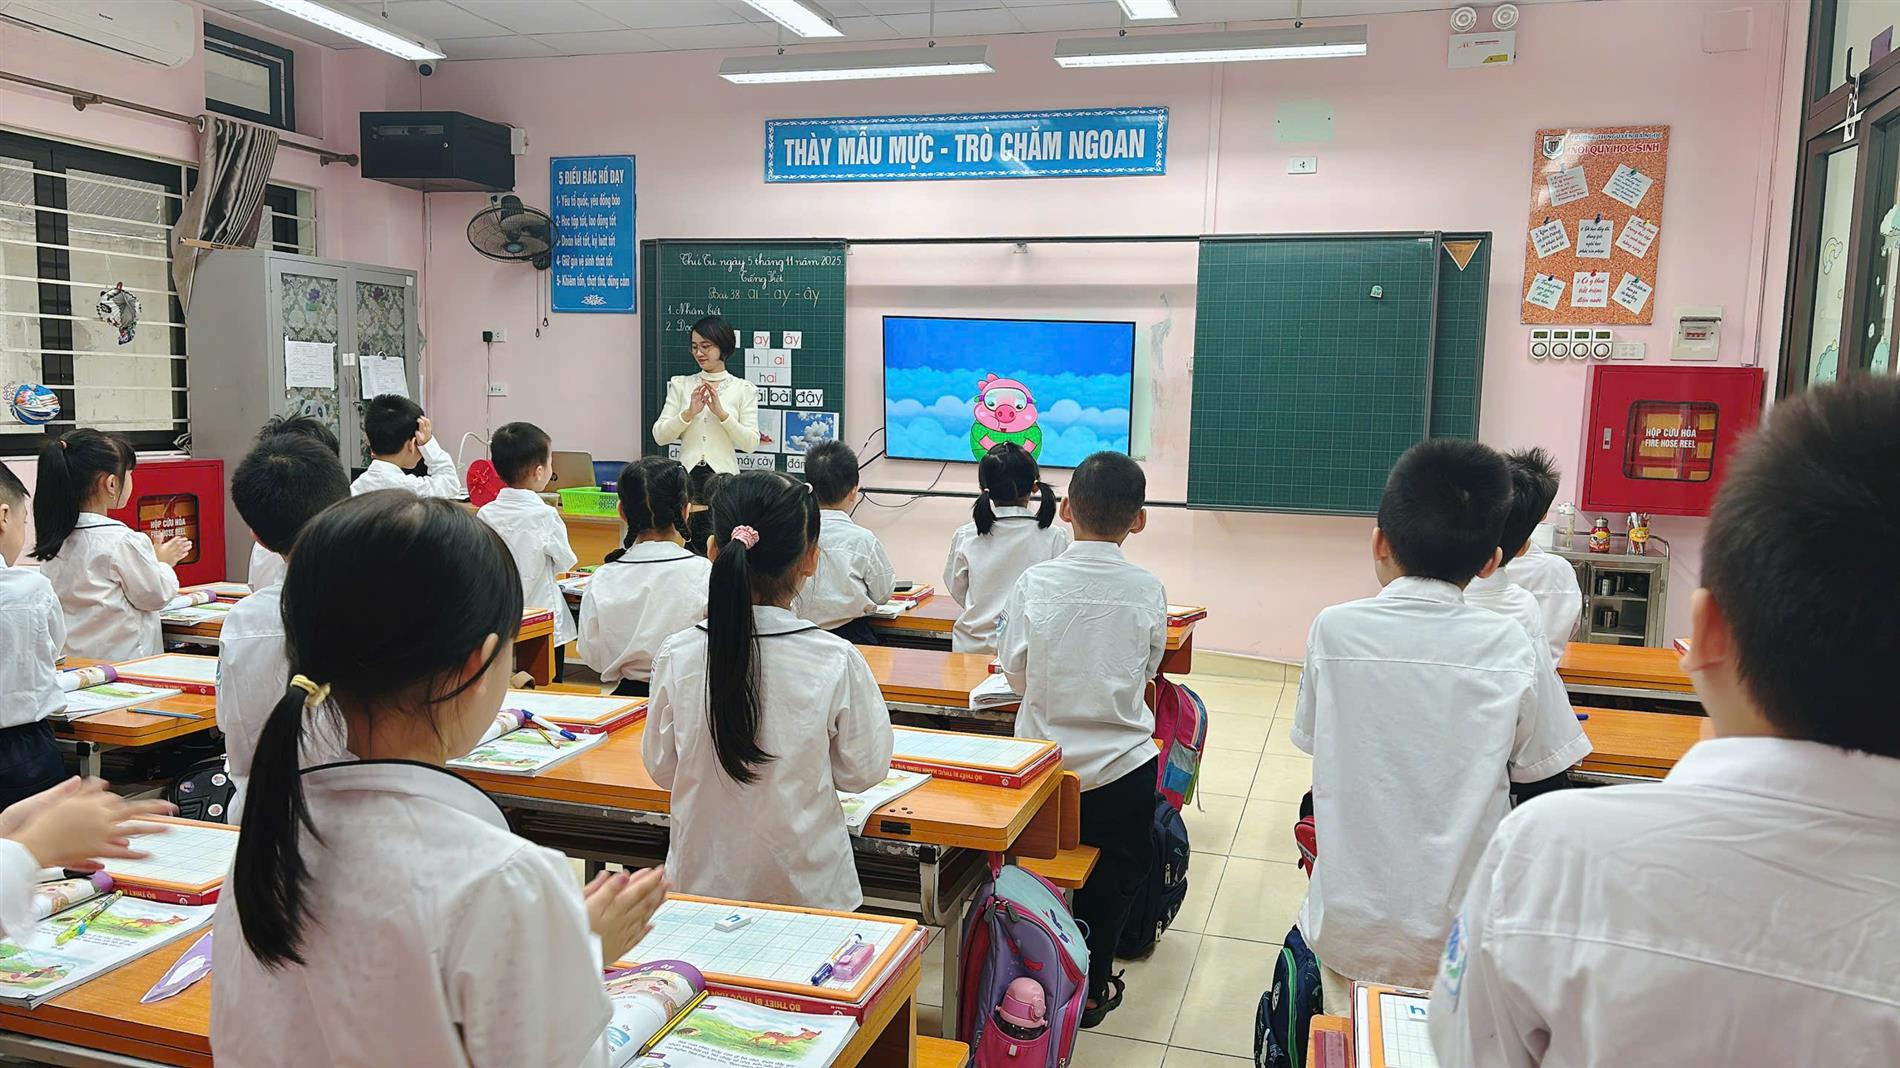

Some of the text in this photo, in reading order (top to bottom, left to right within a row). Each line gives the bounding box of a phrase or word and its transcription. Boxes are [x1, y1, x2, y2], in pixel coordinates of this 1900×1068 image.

[837, 126, 883, 165] MẪU
[888, 132, 935, 169] MỰC
[955, 126, 993, 163] TRÒ
[1000, 125, 1062, 162] CHĂM
[1068, 128, 1145, 160] NGOAN
[1636, 142, 1659, 154] SINH
[558, 170, 564, 185] 5
[582, 167, 597, 185] BÁC
[610, 169, 625, 187] DẠY
[720, 257, 745, 272] ngày
[748, 256, 754, 267] 5
[755, 252, 784, 272] tháng
[786, 256, 794, 266] 11
[821, 256, 842, 267] 2025
[740, 271, 767, 289] Tiếng
[774, 289, 792, 308] ay
[802, 286, 820, 309] ây
[754, 336, 769, 347] ay
[784, 333, 800, 347] ây
[752, 354, 785, 365] h ai
[759, 372, 777, 383] hai
[770, 390, 792, 403] bài
[796, 390, 824, 406] đậy
[1645, 427, 1662, 439] HỘP
[1680, 426, 1697, 438] HỎA
[1645, 439, 1696, 449] FIRE HOSE REEL
[756, 456, 774, 469] cày
